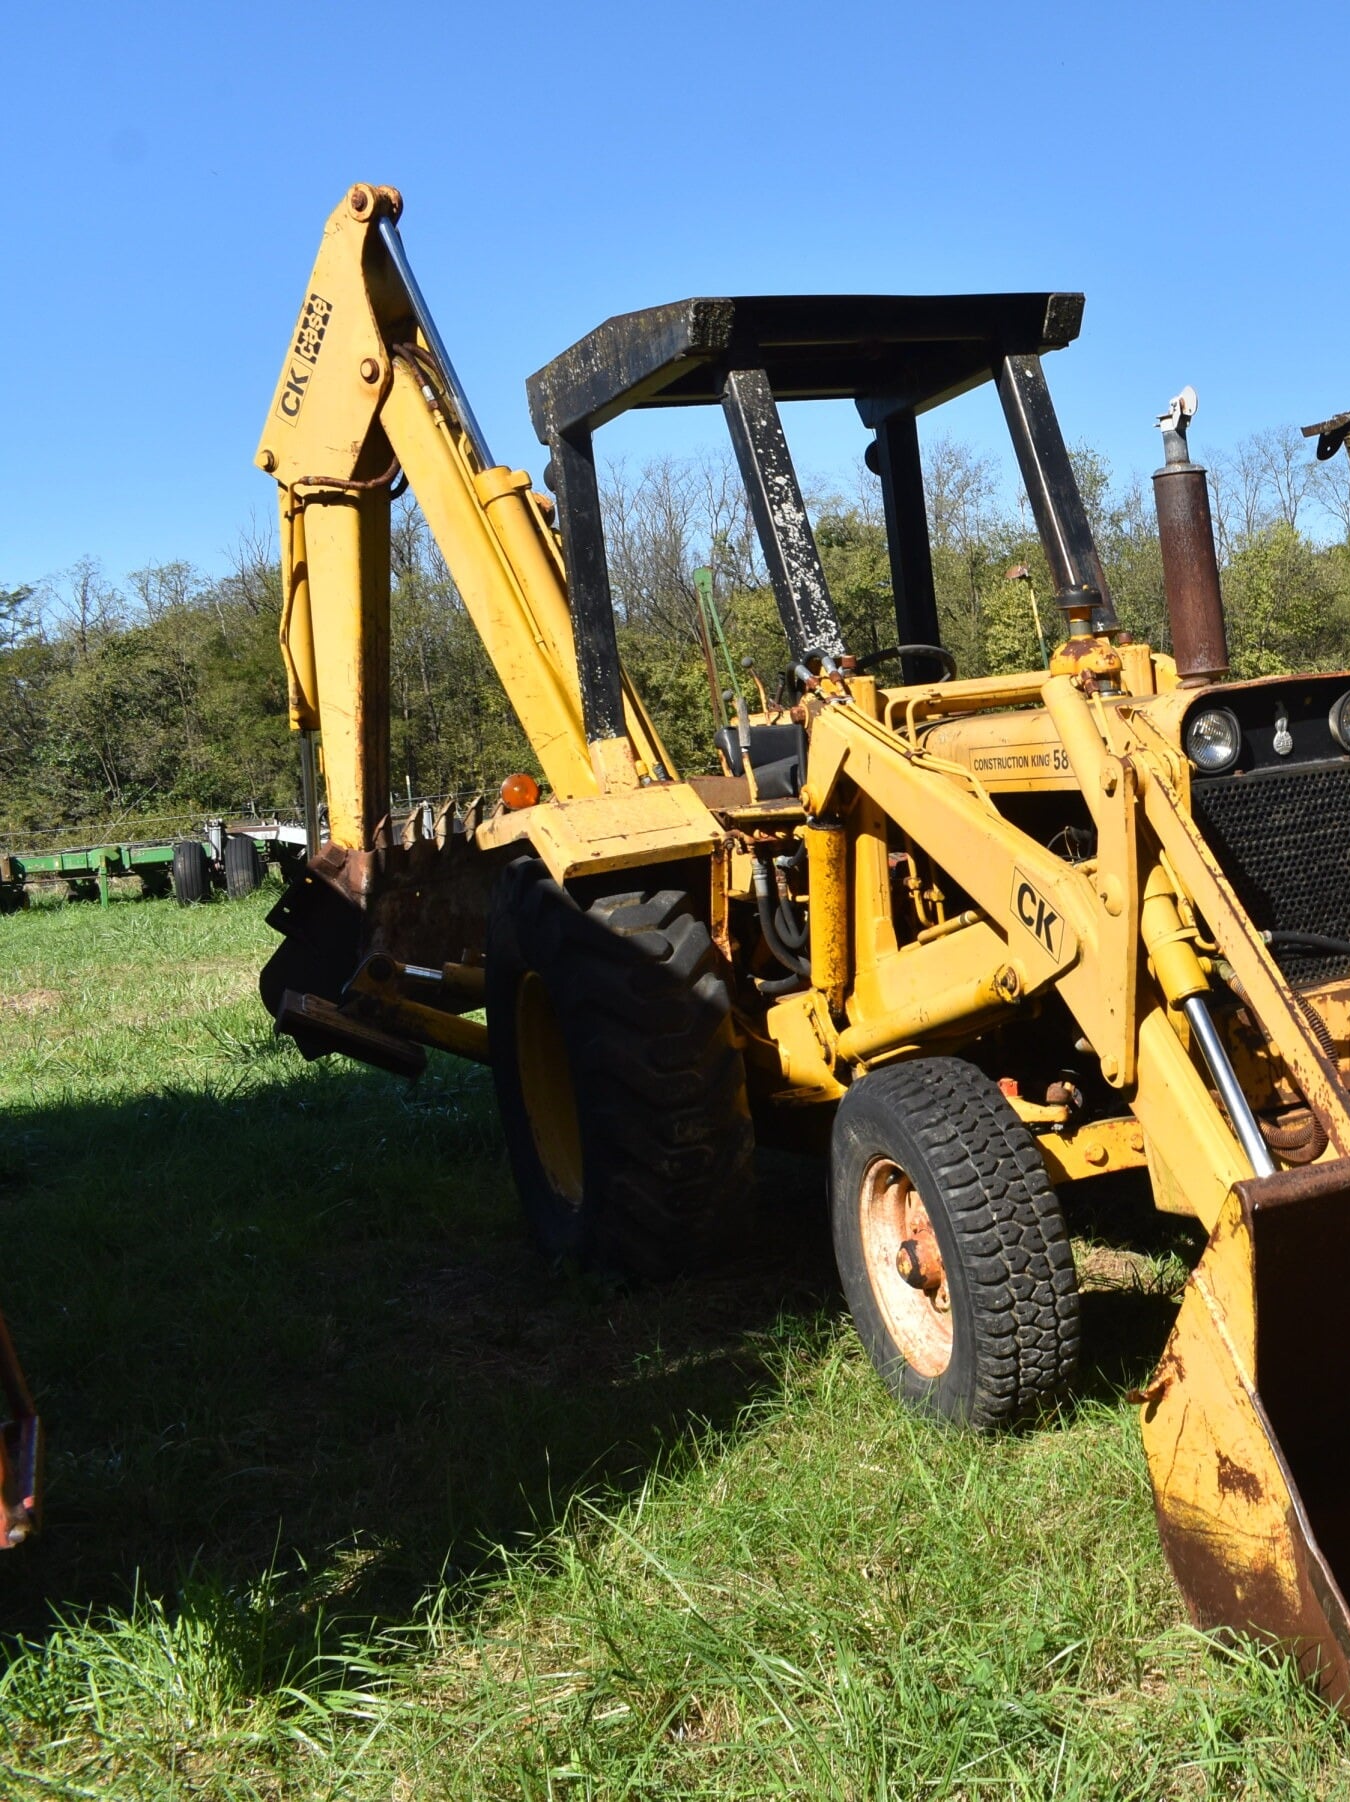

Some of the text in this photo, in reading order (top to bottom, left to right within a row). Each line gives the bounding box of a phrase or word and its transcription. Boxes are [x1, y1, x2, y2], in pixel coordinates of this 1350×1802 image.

[281, 367, 309, 417] CK
[973, 755, 1029, 771] CONSTRUCTION
[1031, 754, 1051, 767] KING
[1017, 882, 1058, 954] CK
